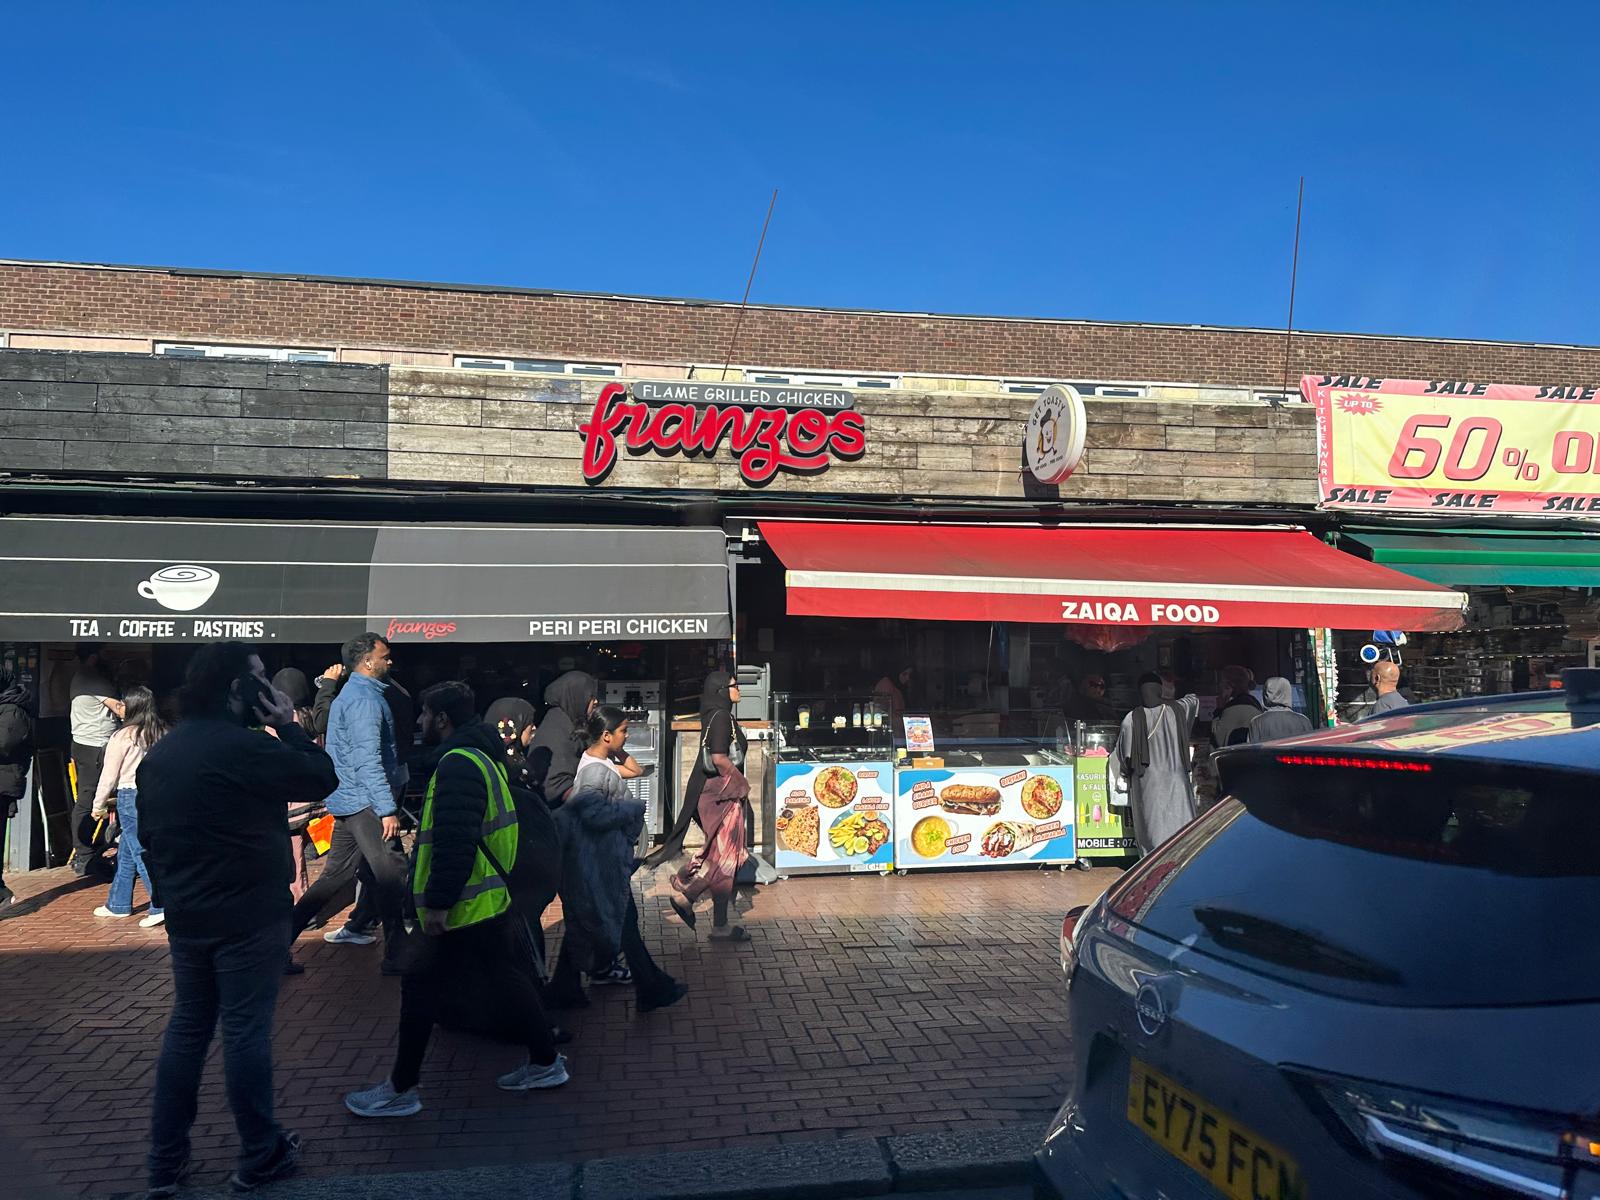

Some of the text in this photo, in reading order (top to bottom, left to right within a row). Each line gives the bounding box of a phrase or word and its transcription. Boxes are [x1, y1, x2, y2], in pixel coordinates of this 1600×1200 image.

[642, 384, 846, 407] FLAME GRILLED CHICKEN
[1317, 375, 1596, 400] SALE SALE SALE
[1032, 395, 1066, 427] GET TOASTY
[1343, 399, 1373, 409] UP TO
[579, 382, 866, 485] franzos
[1317, 389, 1329, 485] KITCHENWARE
[1324, 487, 1600, 512] SALE SALE SALE
[1061, 601, 1220, 623] ZAIQA FOOD
[69, 619, 99, 637] TEA
[118, 619, 175, 638] COFFEE
[193, 620, 264, 638] PASTRIES
[386, 618, 457, 640] franzos
[529, 618, 709, 636] PERI PERI CHICKEN
[1001, 771, 1027, 787] BIRYANI
[1082, 783, 1088, 791] &
[912, 797, 938, 810] BURGER
[1032, 829, 1066, 843] SHAWARMA
[1035, 821, 1060, 833] CHICKEN
[945, 834, 971, 847] CHICKEN
[951, 844, 969, 855] SOUP
[1077, 838, 1115, 848] MOBILE
[1142, 1074, 1218, 1171] EY75
